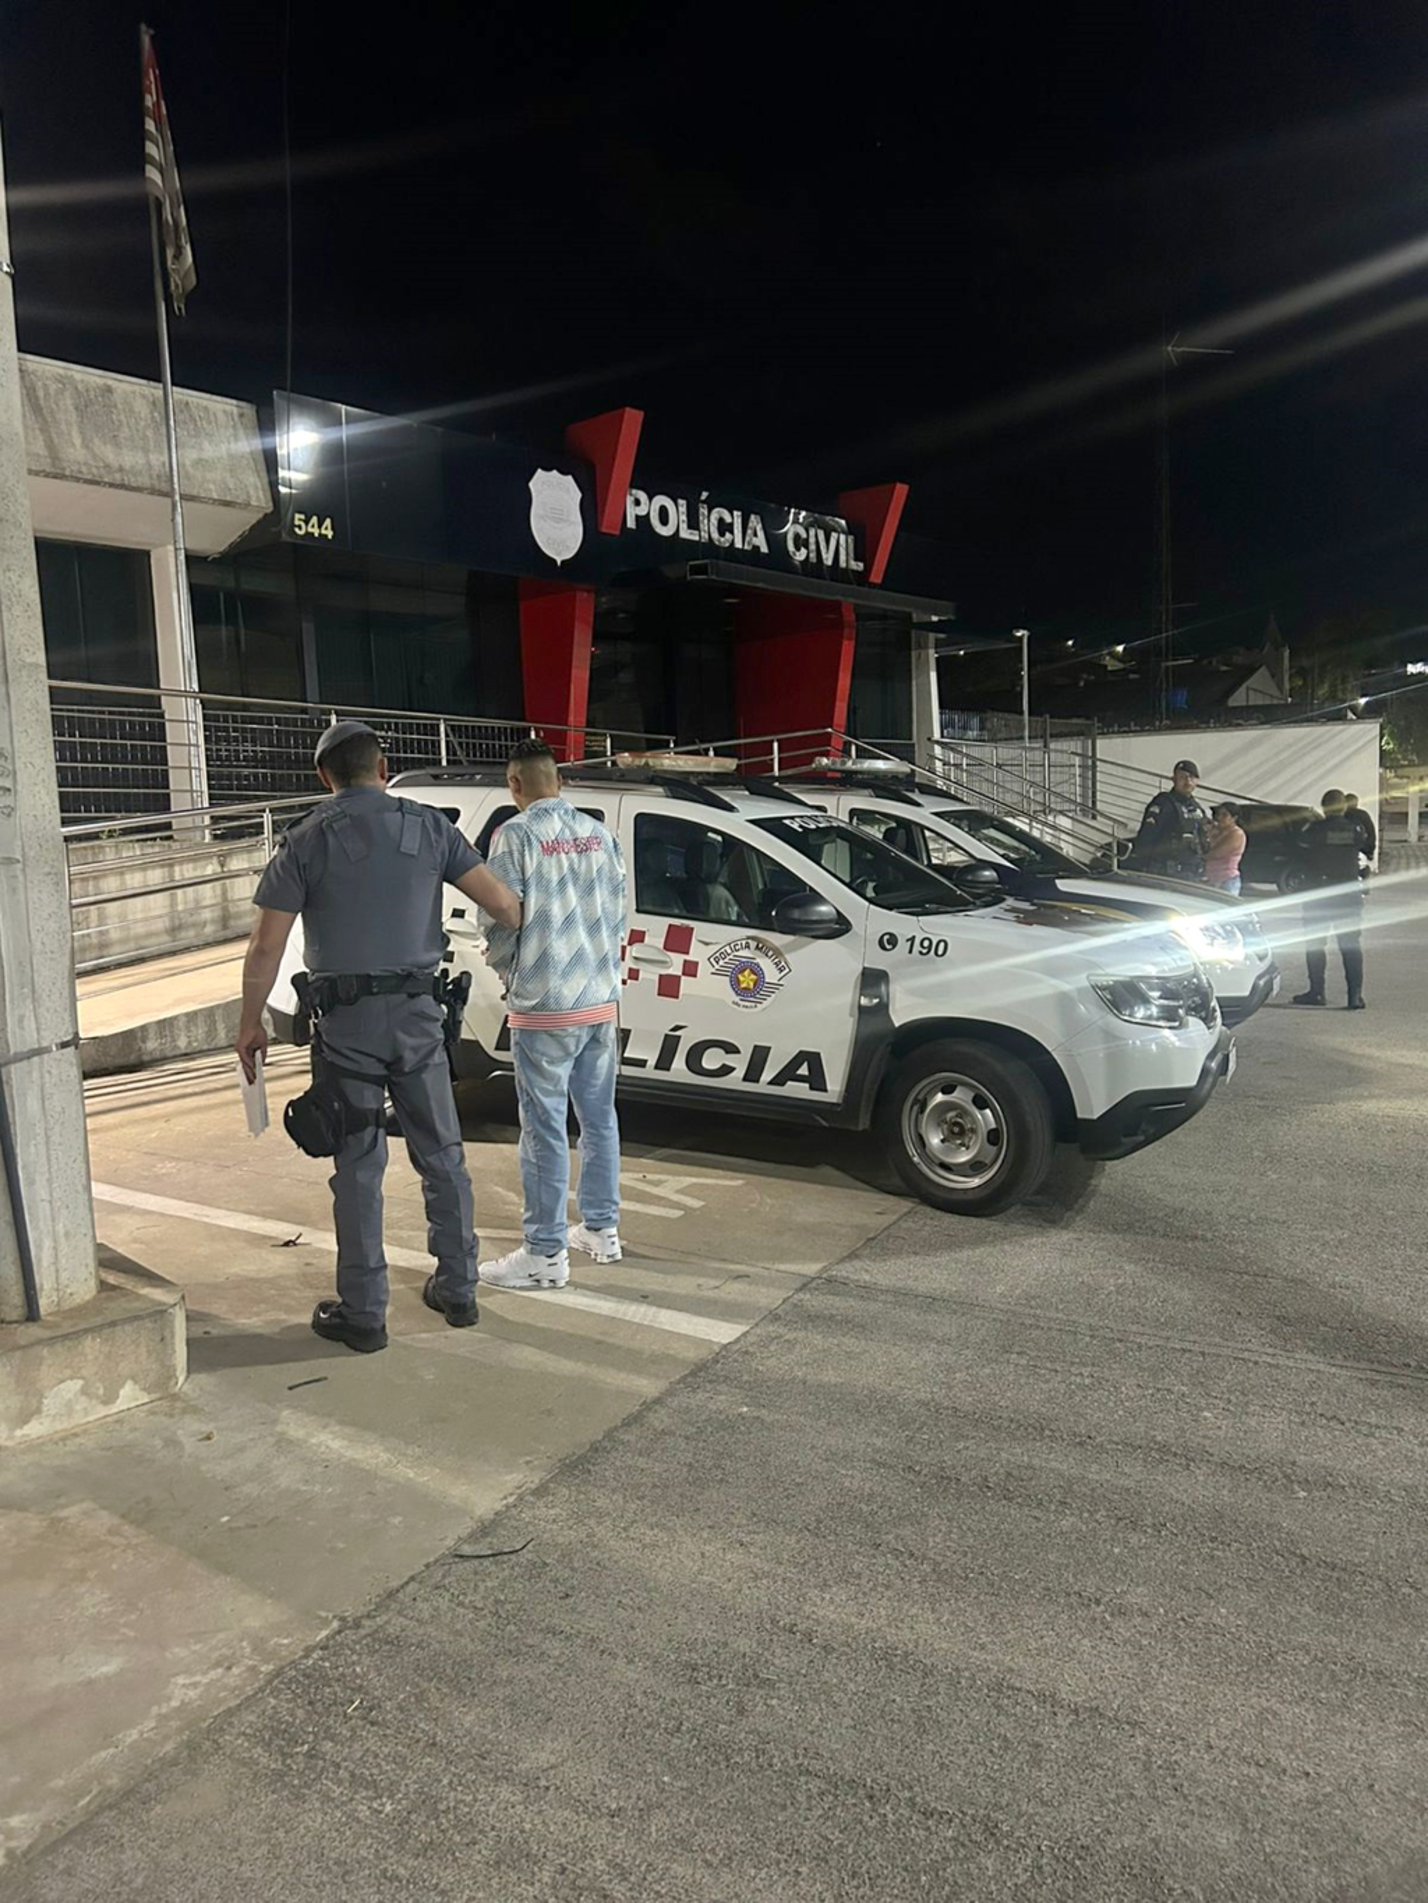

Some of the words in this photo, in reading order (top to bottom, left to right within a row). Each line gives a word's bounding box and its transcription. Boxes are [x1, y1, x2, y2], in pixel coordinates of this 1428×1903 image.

[293, 512, 334, 540] 544
[626, 488, 769, 554] POLÍCIA
[786, 522, 865, 571] CIVIL
[540, 836, 603, 858] MANCHESTER
[713, 941, 751, 965] POLÍCIA
[754, 942, 786, 974] MILITAR
[905, 934, 949, 958] 190
